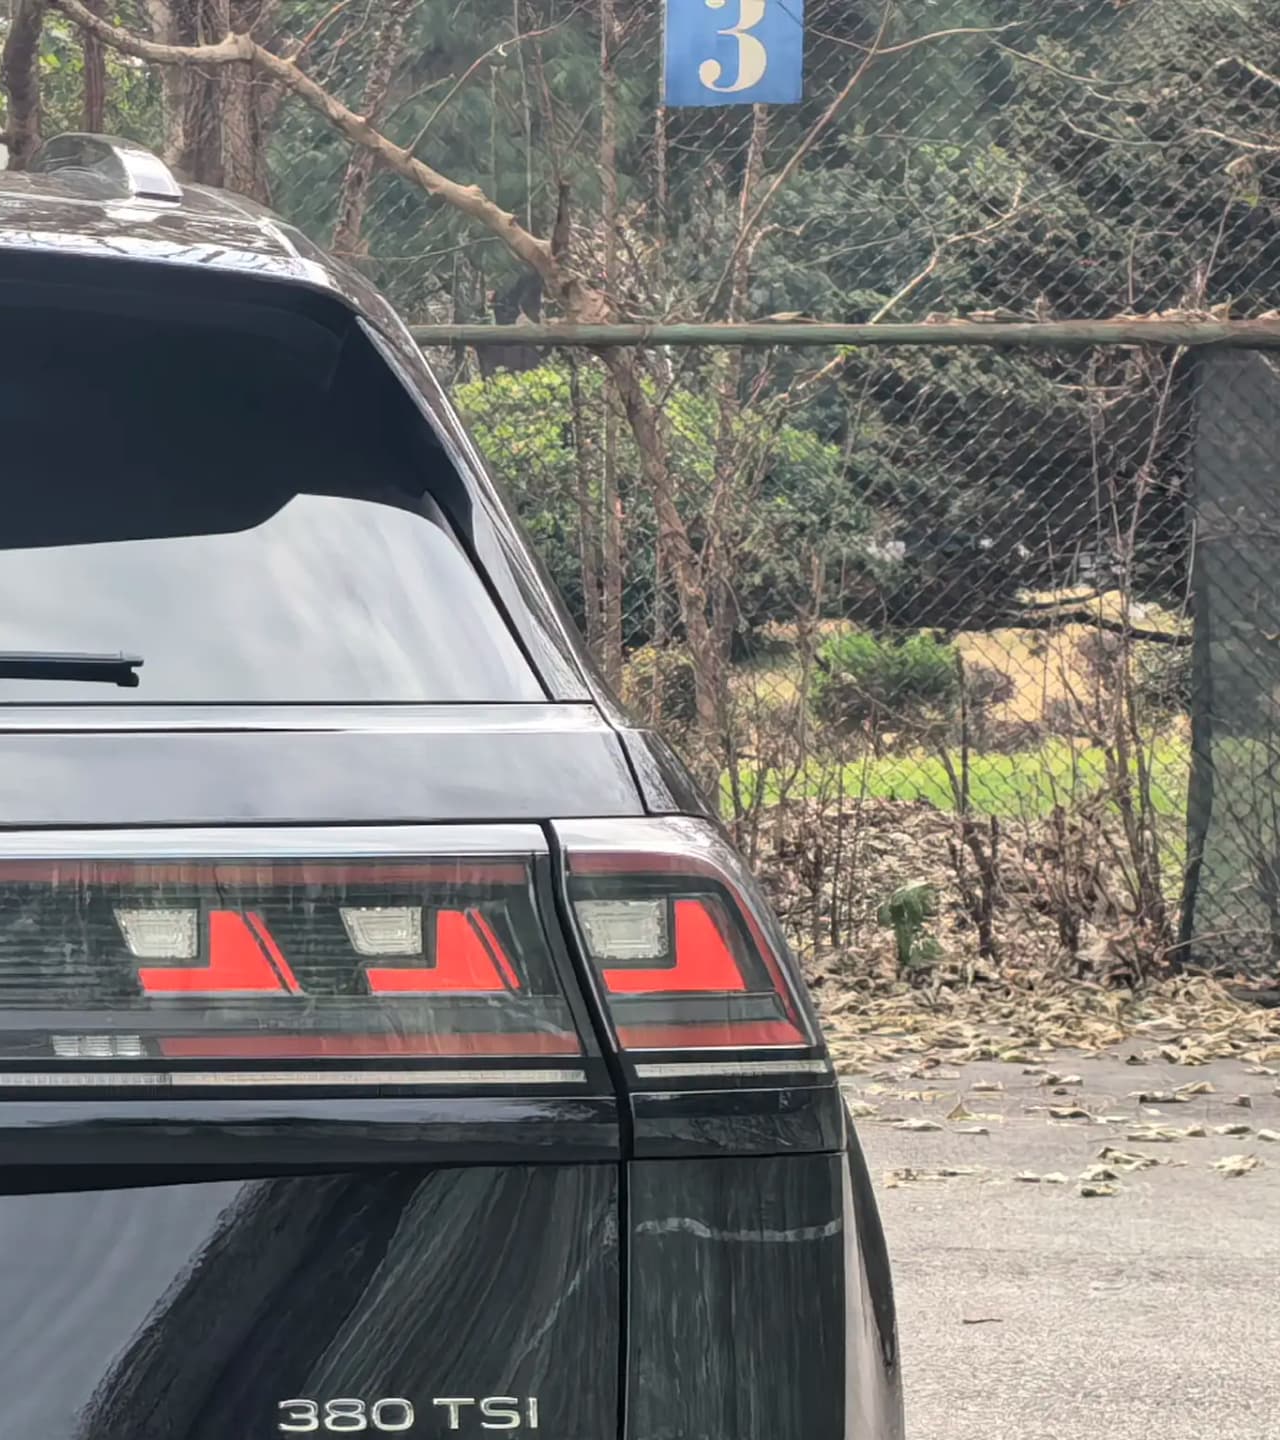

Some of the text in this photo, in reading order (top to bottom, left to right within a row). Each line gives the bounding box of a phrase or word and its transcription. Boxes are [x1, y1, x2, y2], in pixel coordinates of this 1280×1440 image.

[698, 0, 767, 93] 3
[277, 1396, 539, 1432] 380 TSI
